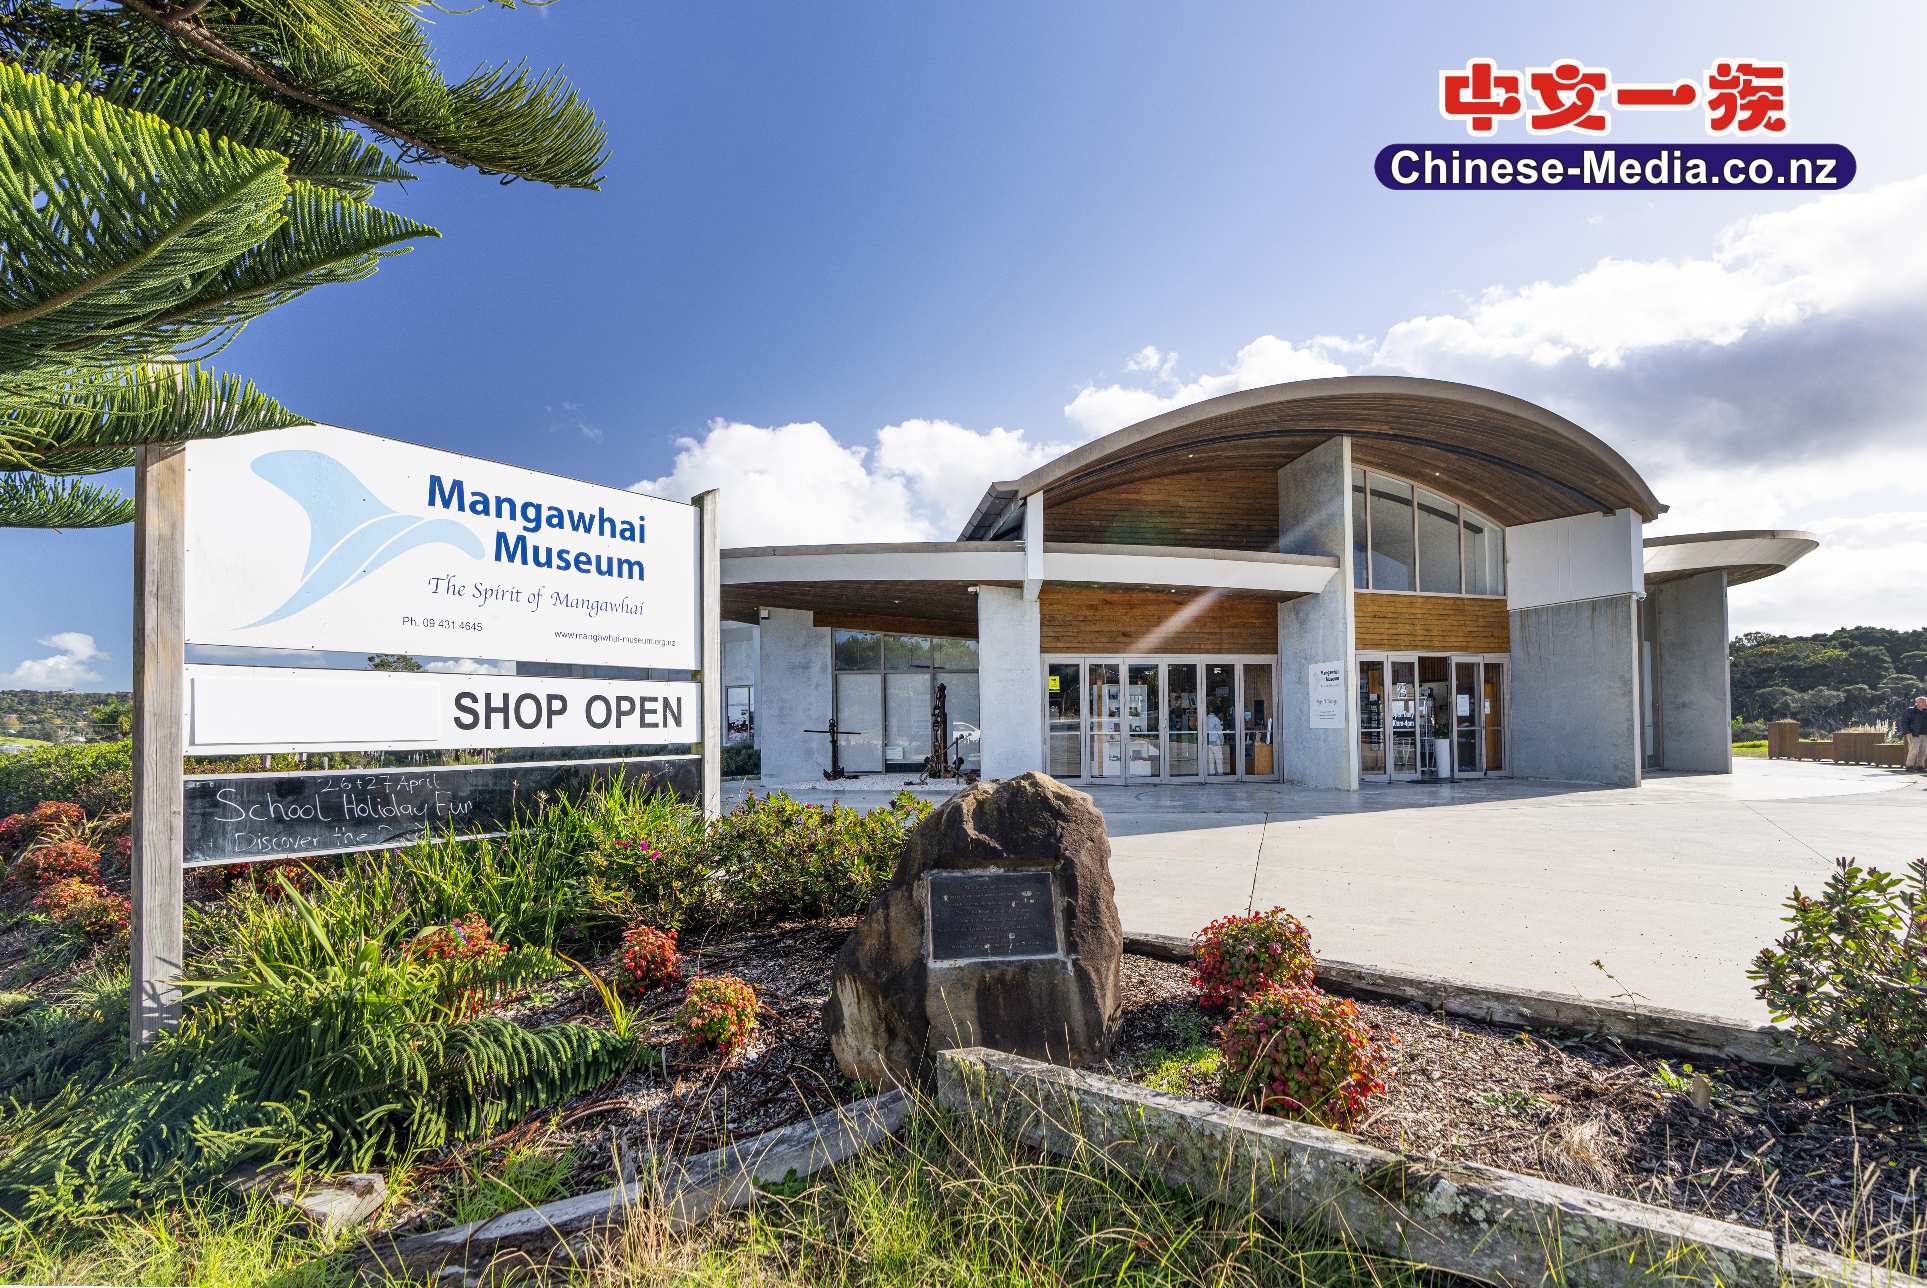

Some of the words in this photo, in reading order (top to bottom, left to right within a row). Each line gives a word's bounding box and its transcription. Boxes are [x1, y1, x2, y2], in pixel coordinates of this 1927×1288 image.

[427, 474, 646, 543] Mangawhai
[494, 529, 645, 581] Museum
[428, 573, 466, 597] The
[472, 581, 523, 608] Spirit
[527, 585, 546, 613] of
[550, 591, 645, 618] Mangawhai
[402, 616, 420, 627] Ph.
[422, 617, 436, 628] 09
[437, 619, 455, 630] 431
[458, 620, 483, 632] 4645
[453, 691, 568, 731] SHOP
[585, 694, 682, 730] OPEN
[397, 773, 440, 794] April
[214, 788, 333, 822] School
[343, 793, 428, 821] Holiday
[435, 790, 474, 817] Fun
[234, 832, 320, 853] Discover
